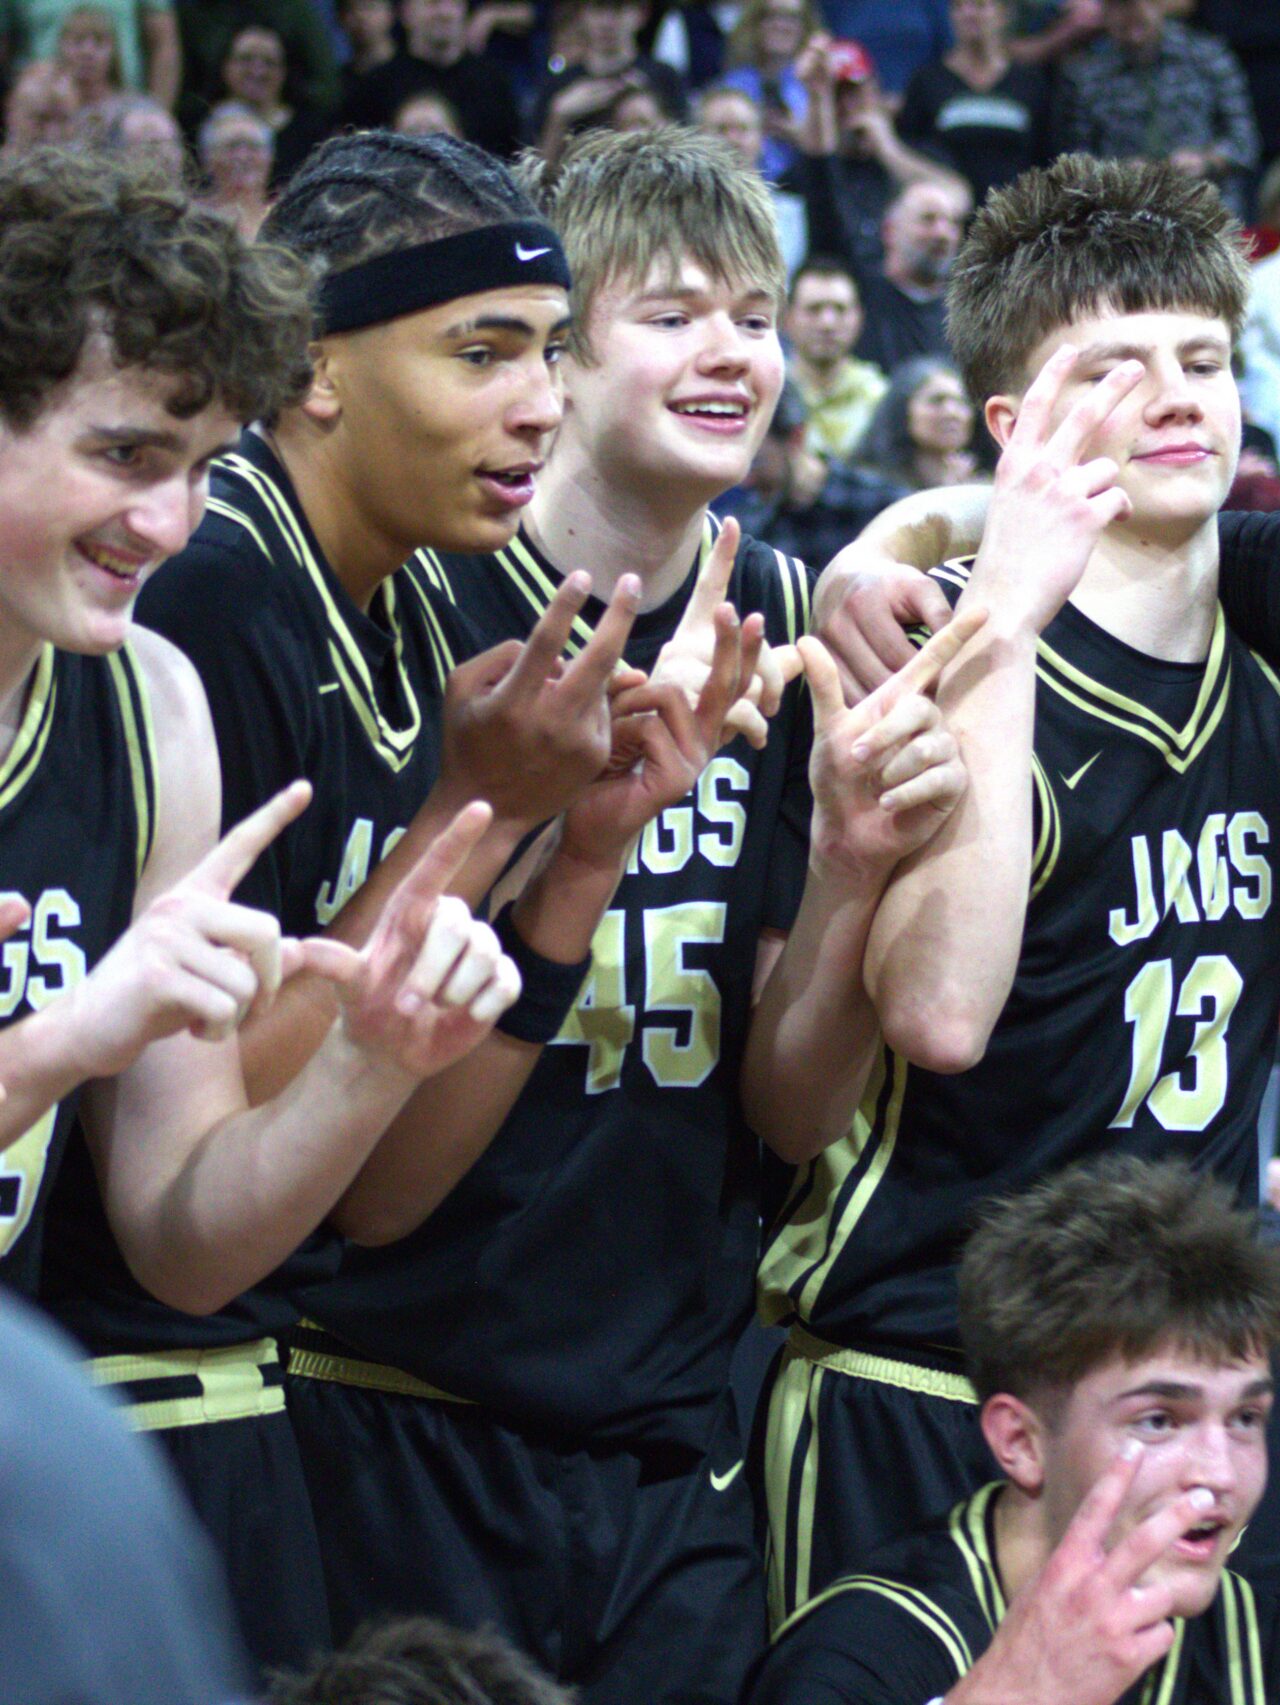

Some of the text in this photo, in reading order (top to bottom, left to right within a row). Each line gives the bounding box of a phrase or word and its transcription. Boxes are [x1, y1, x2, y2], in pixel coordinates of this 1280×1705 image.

[1107, 811, 1272, 946] JAGS
[546, 901, 727, 1095] 45
[1107, 954, 1245, 1132] 13
